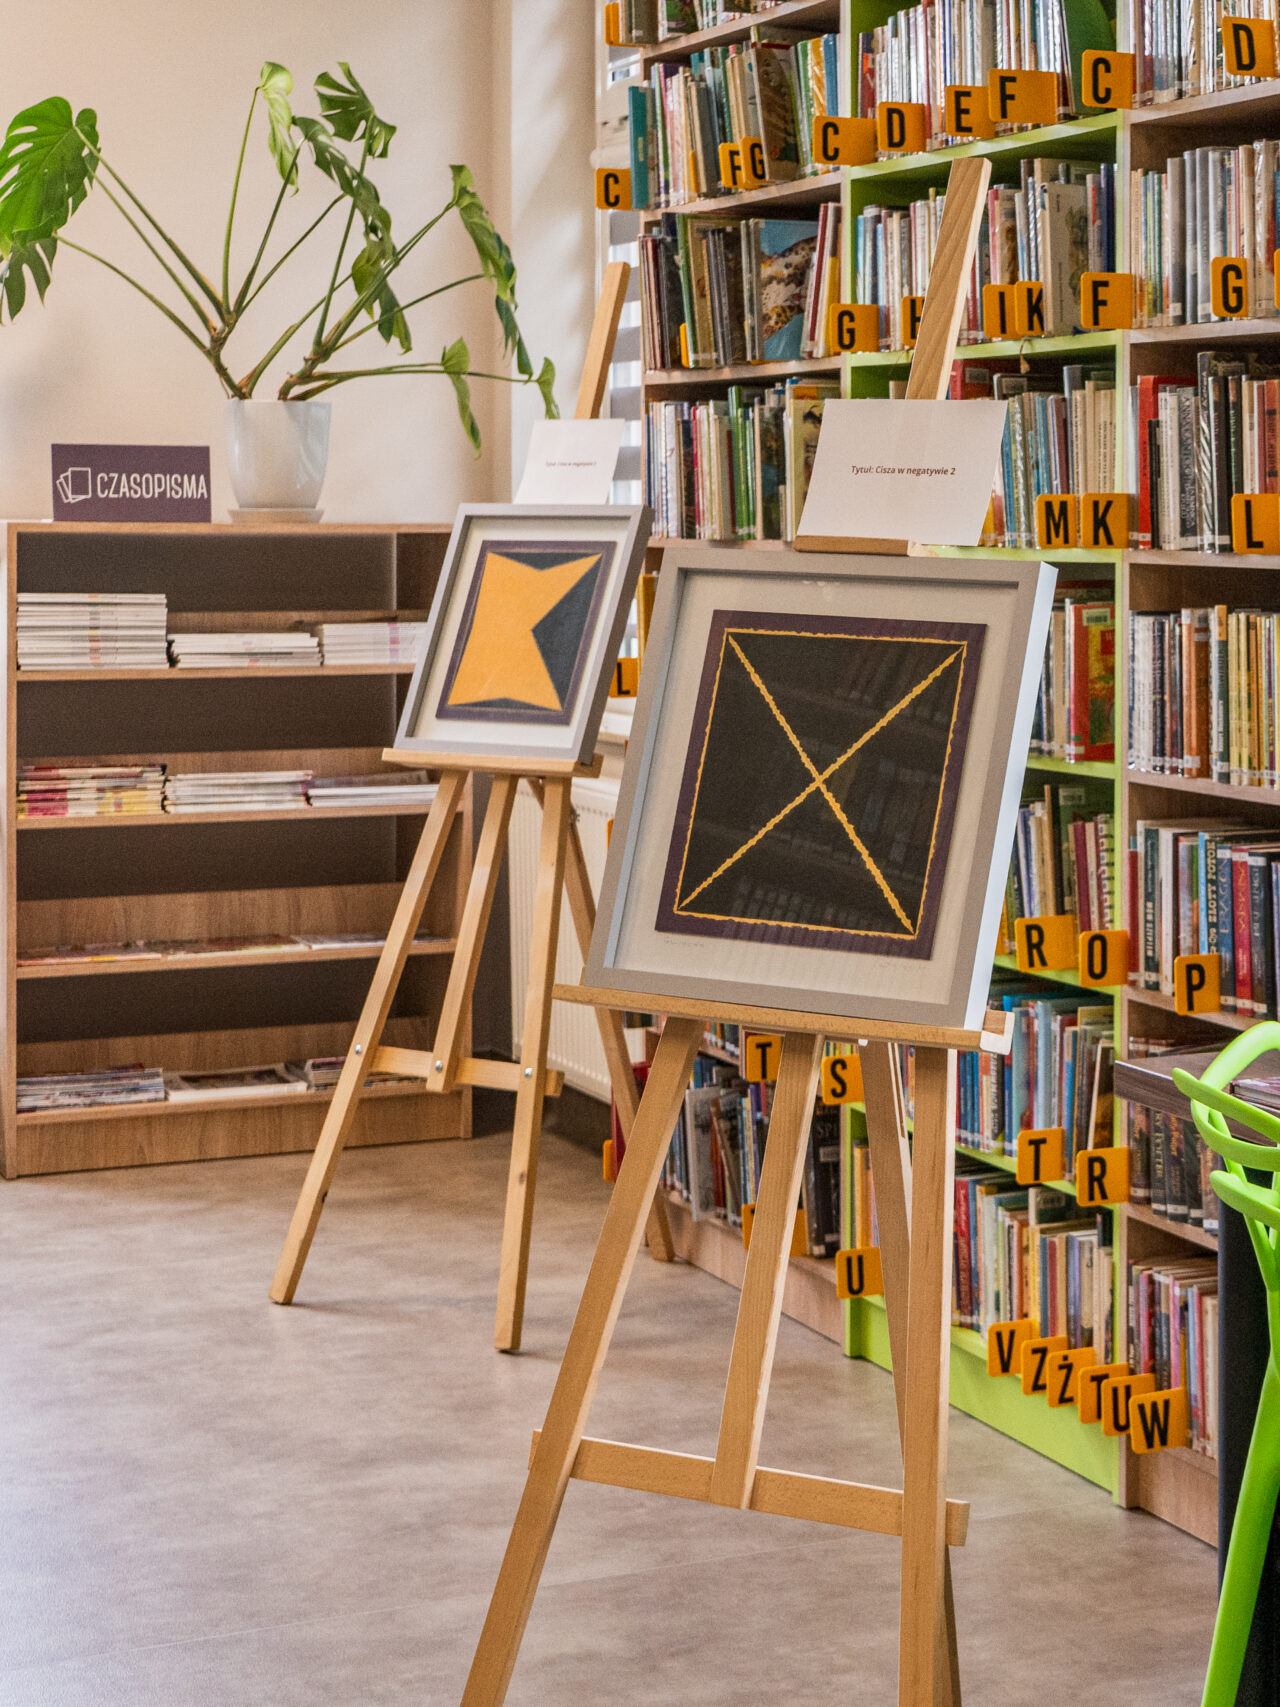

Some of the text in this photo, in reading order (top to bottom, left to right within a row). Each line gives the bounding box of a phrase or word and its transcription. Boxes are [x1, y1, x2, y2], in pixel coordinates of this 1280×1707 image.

[1232, 23, 1256, 72] D
[999, 75, 1017, 119] F
[1092, 57, 1112, 105] C
[886, 107, 906, 148] D
[954, 90, 973, 134] E
[749, 142, 766, 181] G
[822, 121, 840, 162] C
[603, 172, 620, 208] C
[729, 150, 742, 186] F
[1026, 287, 1045, 332] K
[1091, 280, 1110, 327] F
[1221, 263, 1243, 314] G
[837, 310, 856, 350] G
[998, 291, 1007, 335] I
[96, 472, 209, 499] CZASOPISMA
[851, 465, 874, 475] Tytuł:
[875, 465, 896, 474] Cisza
[906, 466, 949, 477] negatywie
[950, 467, 956, 475] 2
[1044, 500, 1070, 545] M
[1092, 500, 1114, 546] K
[1244, 499, 1264, 549] L
[616, 662, 631, 696] L
[1025, 924, 1048, 968] R
[1087, 933, 1108, 980] O
[1185, 963, 1206, 1012] P
[755, 1041, 773, 1080] T
[830, 1058, 847, 1099] S
[1028, 1137, 1047, 1182] T
[1087, 1156, 1109, 1202] R
[846, 1254, 865, 1296] U
[996, 1329, 1015, 1374] V
[1031, 1346, 1048, 1392] Z
[1058, 1355, 1074, 1405] Ż
[1112, 1384, 1132, 1433] U
[1137, 1399, 1170, 1449] W
